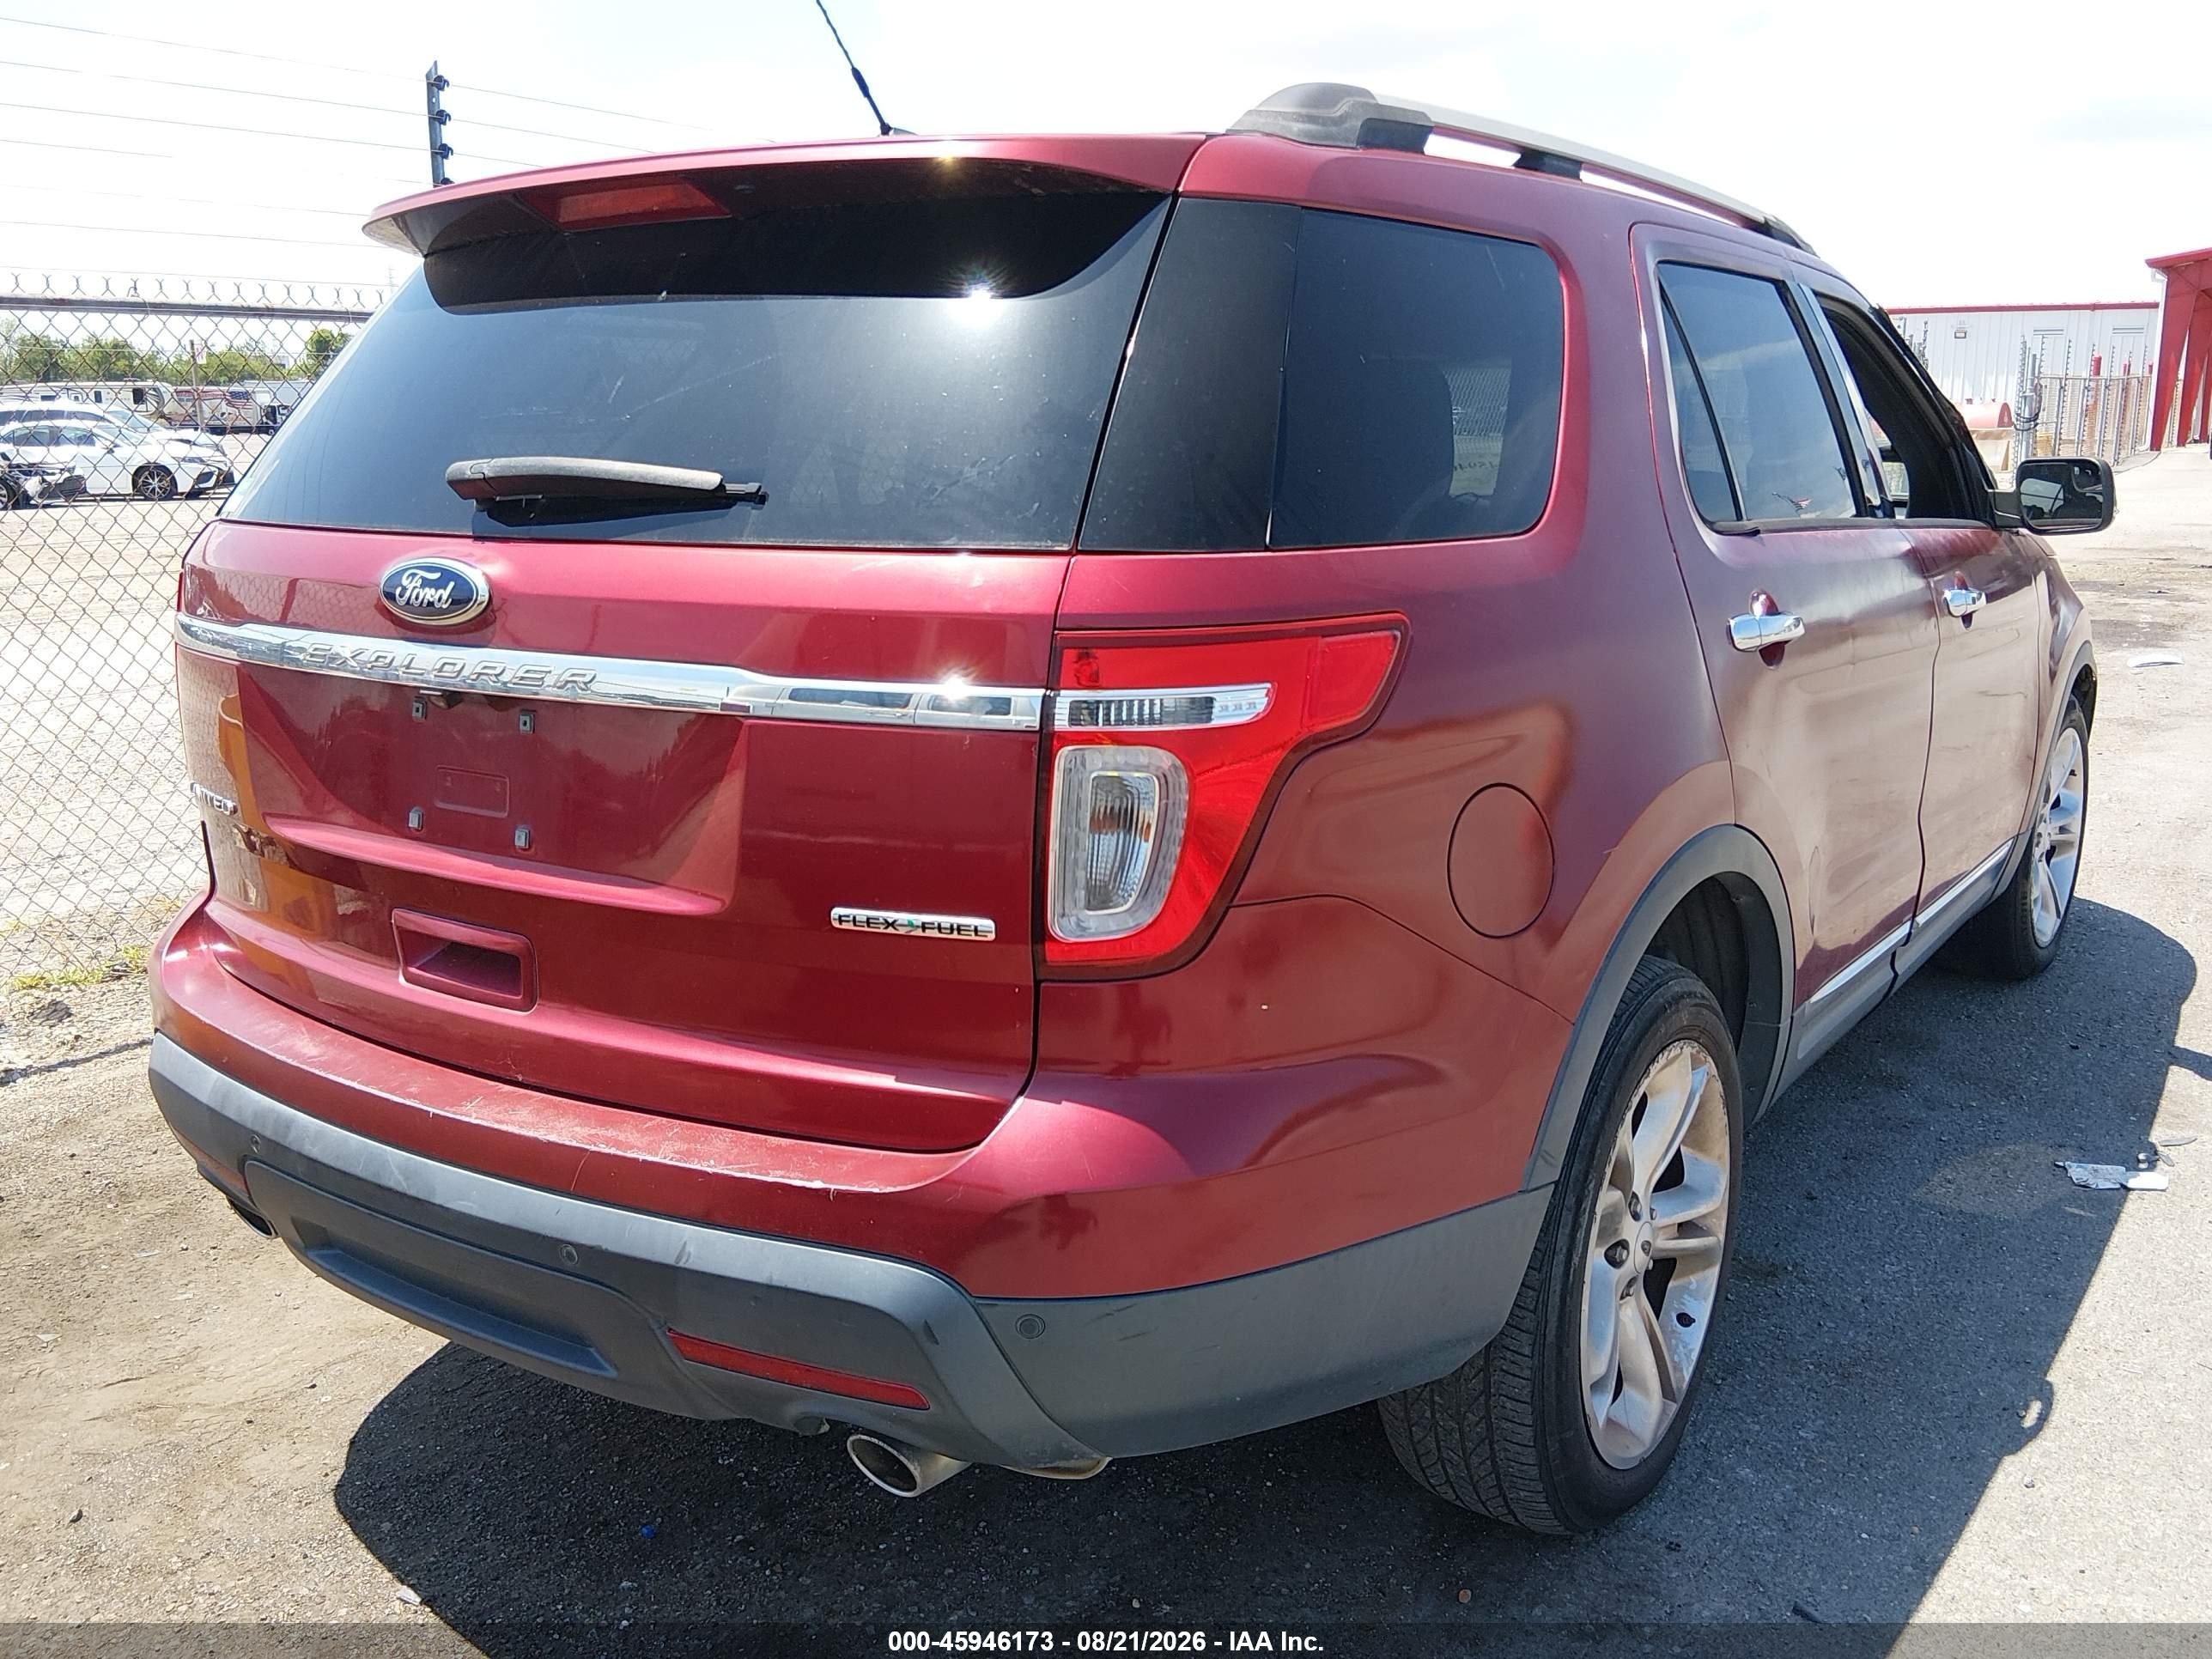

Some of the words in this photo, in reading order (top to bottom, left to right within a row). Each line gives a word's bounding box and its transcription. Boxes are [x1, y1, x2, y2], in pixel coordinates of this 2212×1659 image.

[395, 568, 456, 609] Ford
[301, 642, 599, 693] EXPLORER
[837, 913, 899, 932] FLEX
[921, 921, 988, 938] FUEL
